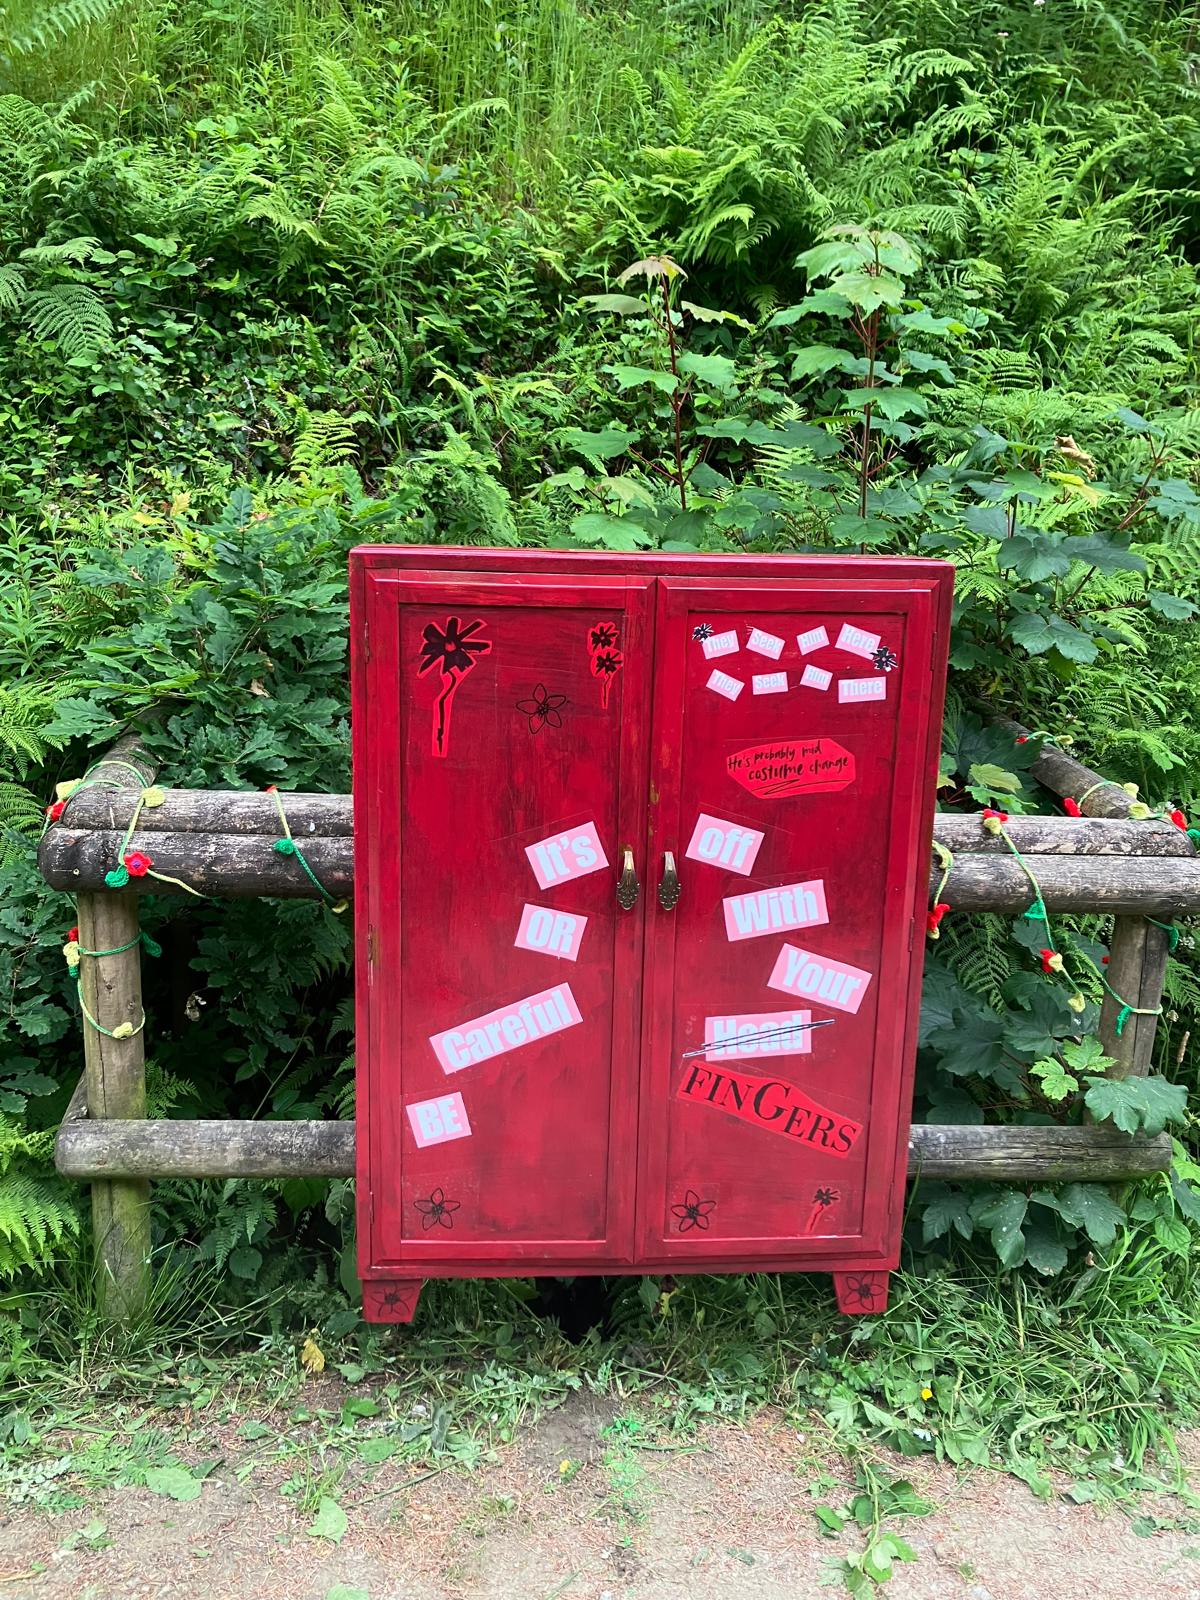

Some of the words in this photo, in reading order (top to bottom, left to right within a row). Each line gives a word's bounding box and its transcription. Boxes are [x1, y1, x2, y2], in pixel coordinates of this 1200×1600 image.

[707, 635, 735, 651] They
[751, 631, 781, 655] Seek
[800, 629, 825, 651] Him
[842, 626, 875, 652] Here
[713, 673, 740, 696] They
[755, 674, 785, 689] Seek
[806, 667, 829, 685] Him
[842, 680, 882, 698] There
[728, 756, 751, 772] He's
[754, 745, 796, 762] probably
[748, 761, 805, 782] costume
[809, 756, 849, 775] change
[534, 834, 599, 882] It's
[525, 908, 577, 954] OR
[730, 885, 820, 935] With
[782, 949, 862, 1006] Your
[440, 988, 573, 1069] Careful
[713, 1014, 804, 1056] Head
[414, 1096, 463, 1141] BE
[682, 1065, 858, 1154] FINGERS
